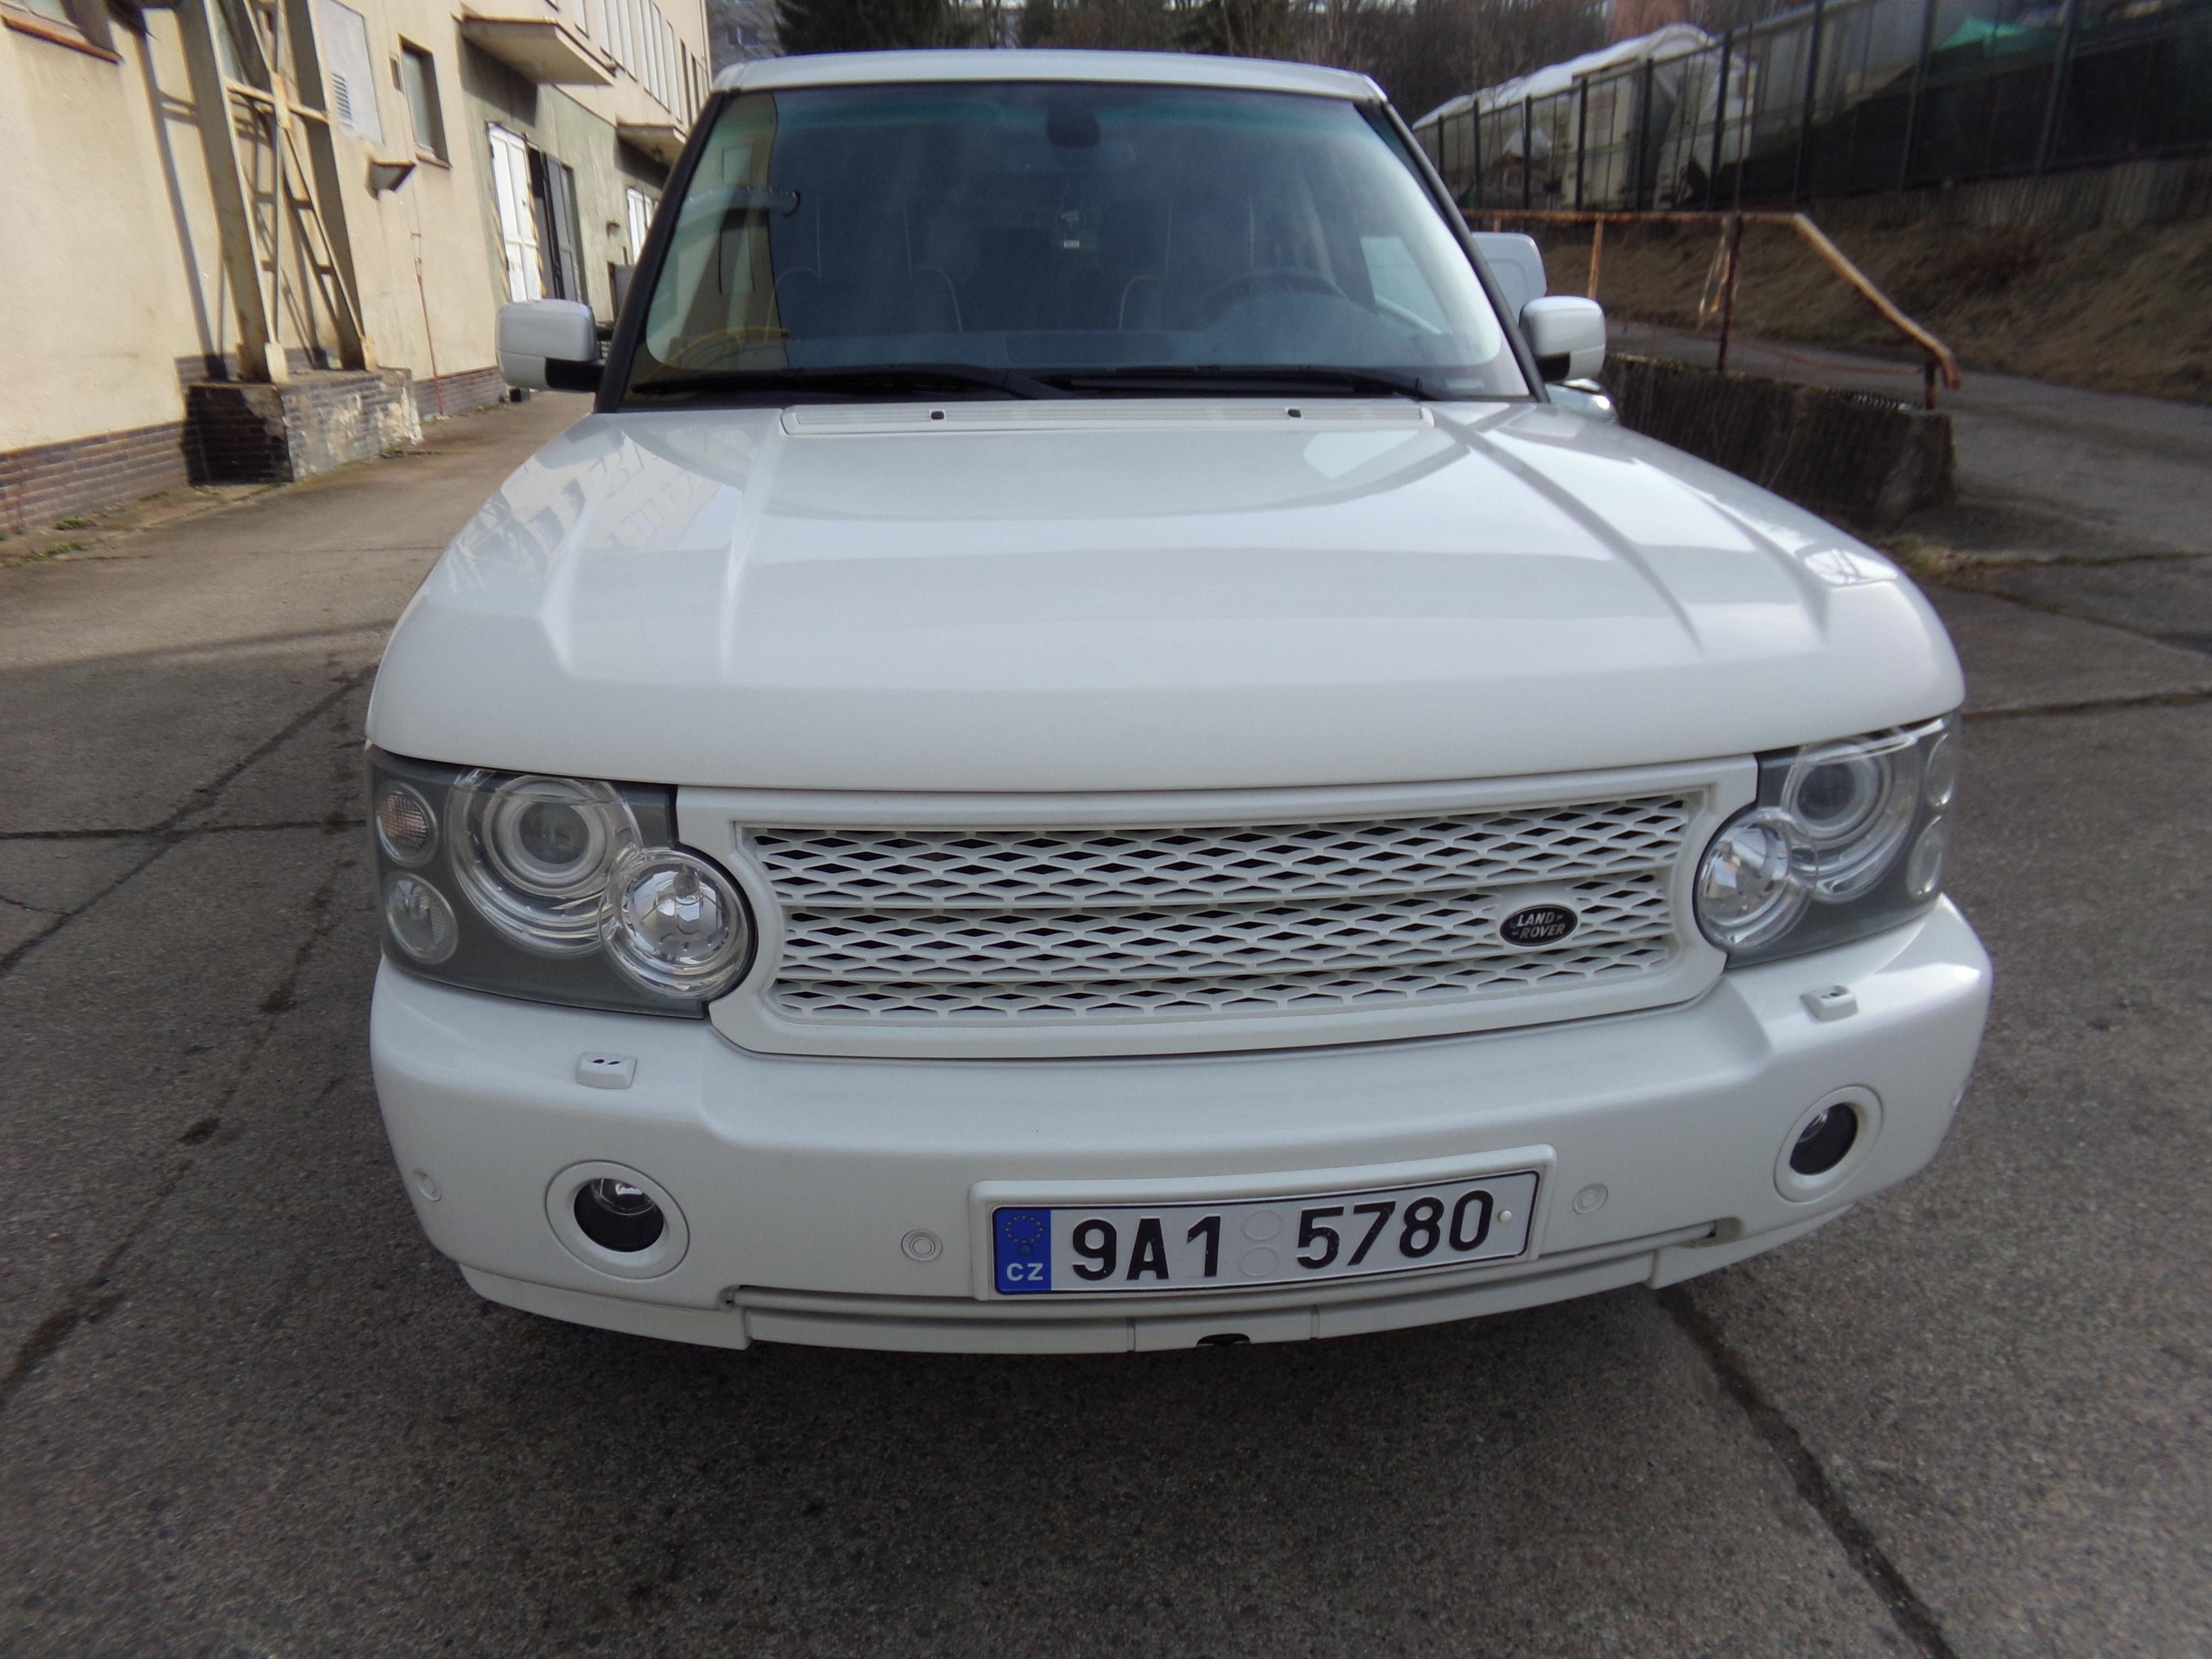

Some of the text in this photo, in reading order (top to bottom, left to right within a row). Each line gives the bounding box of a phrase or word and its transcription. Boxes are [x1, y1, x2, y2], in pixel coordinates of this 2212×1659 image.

[1516, 911, 1555, 927] LAND
[1519, 923, 1566, 939] ROVER
[1071, 1190, 1494, 1280] 9A1 5780
[1007, 1263, 1043, 1281] CZ
